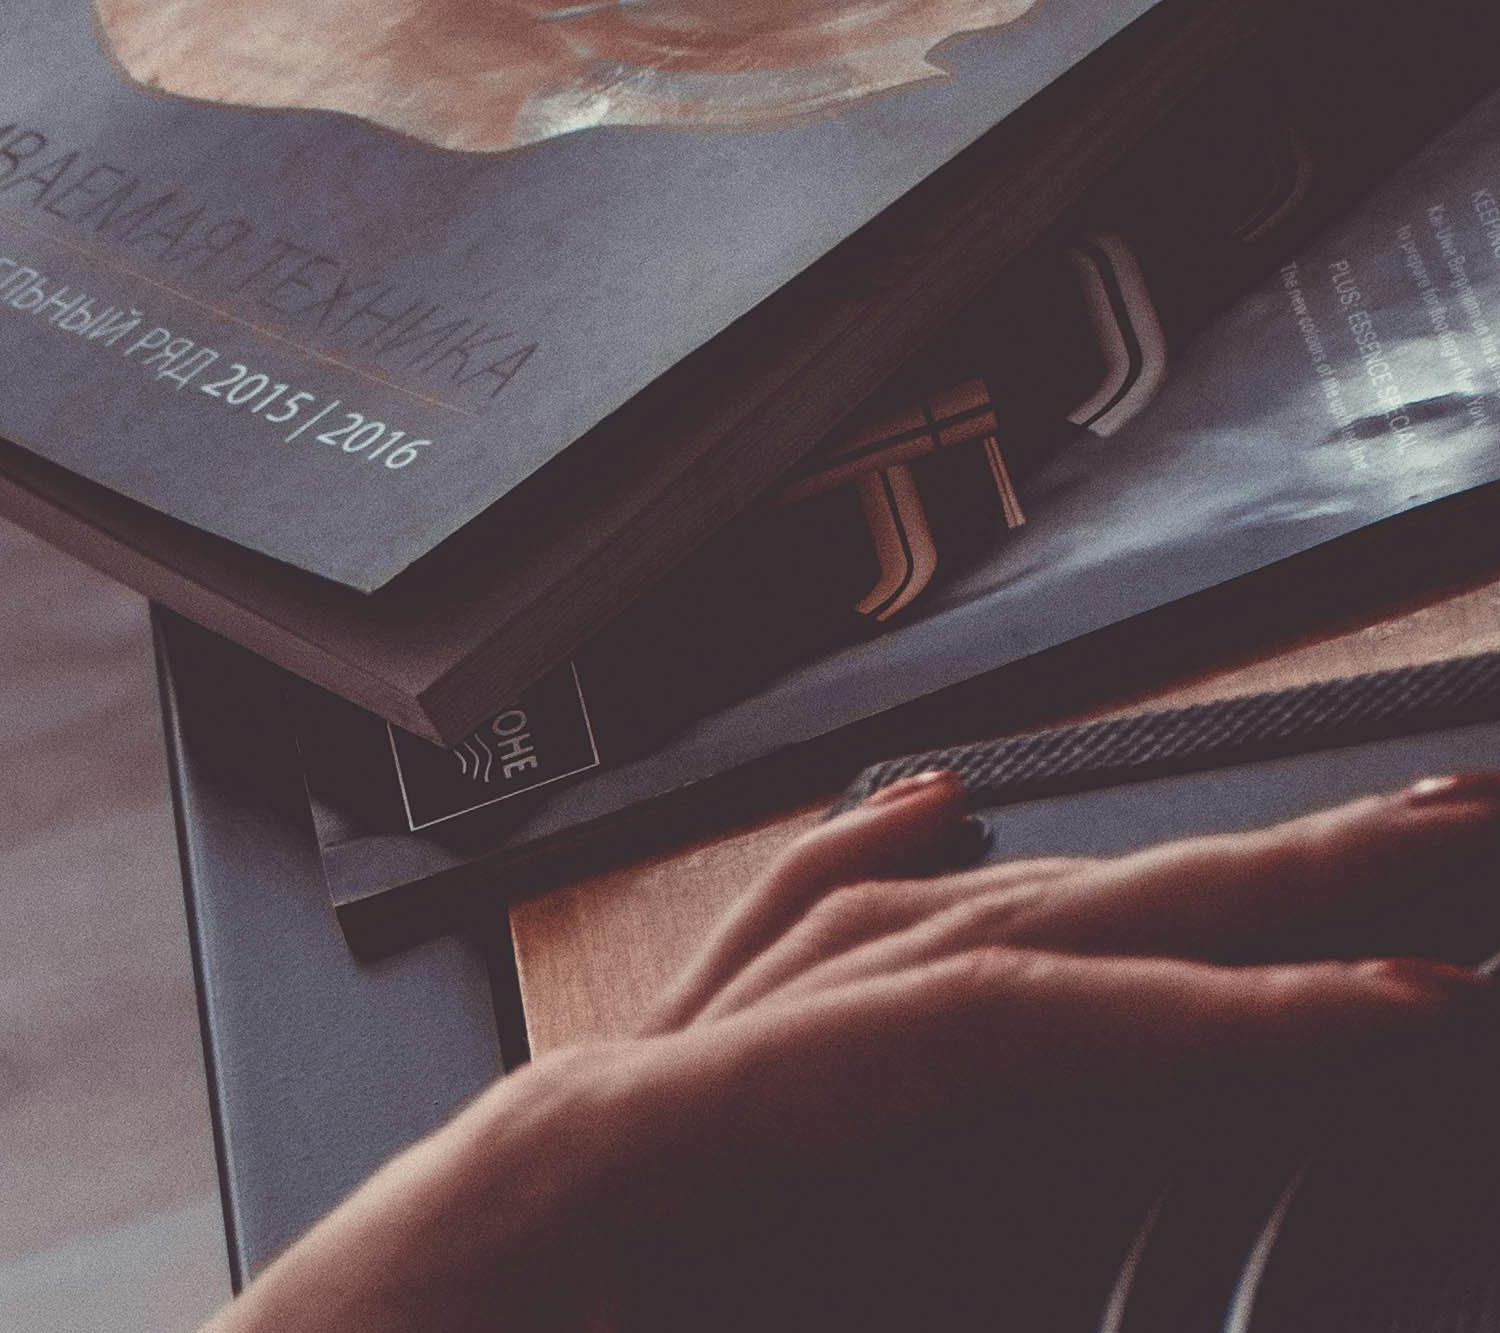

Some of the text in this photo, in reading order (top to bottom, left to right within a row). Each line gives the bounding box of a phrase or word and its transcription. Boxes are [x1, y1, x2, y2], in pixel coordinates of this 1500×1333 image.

[1397, 225, 1412, 240] to
[1281, 262, 1300, 288] The
[1400, 241, 1432, 289] prepare
[1444, 256, 1483, 319] Bergmann
[233, 236, 539, 400] ТЕХНИКА
[1289, 289, 1307, 314] new
[124, 326, 220, 390] РЯД
[1348, 310, 1392, 385] ESSENCE
[1378, 384, 1419, 453] SPECIAL
[491, 709, 539, 780] OHE
